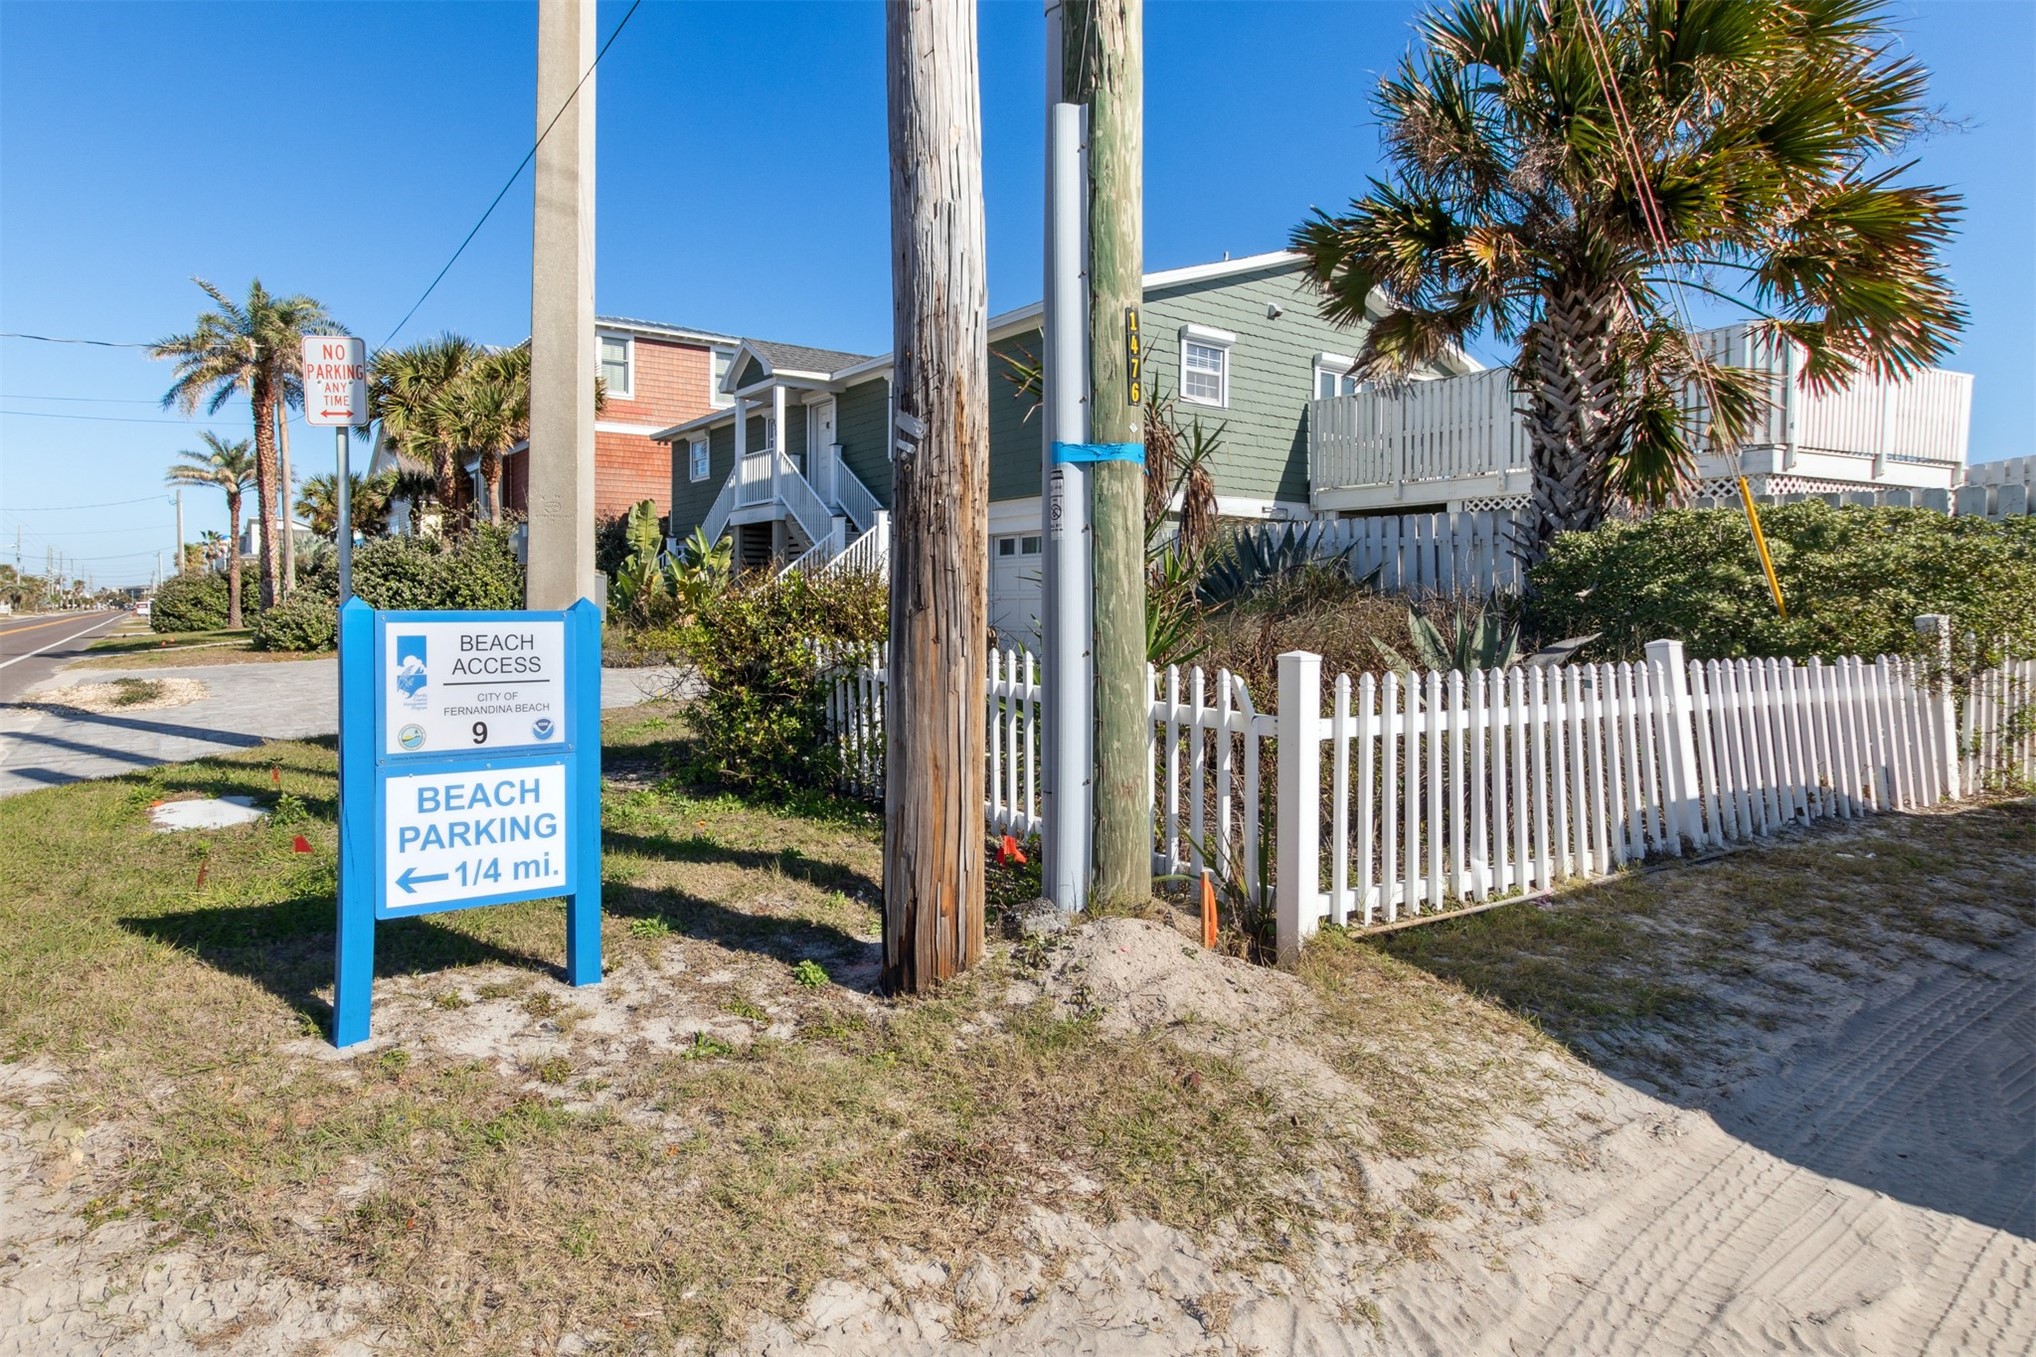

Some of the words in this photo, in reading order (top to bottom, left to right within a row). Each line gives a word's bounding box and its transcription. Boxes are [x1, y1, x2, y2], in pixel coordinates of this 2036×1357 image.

[322, 344, 345, 360] NO
[1129, 312, 1139, 402] 1476
[307, 364, 364, 380] PARKING
[324, 382, 347, 393] ANY
[324, 395, 349, 406] TIME
[461, 634, 533, 651] BEACH
[452, 656, 541, 675] ACCESS
[478, 693, 501, 702] CITY
[504, 692, 518, 700] OF
[444, 705, 513, 716] FERNANDINA
[515, 703, 549, 712] BEACH
[472, 722, 487, 744] 9
[417, 778, 540, 813] BEACH
[399, 812, 557, 854] PARKING
[455, 858, 501, 886] 1/4
[514, 852, 558, 880] mi.
